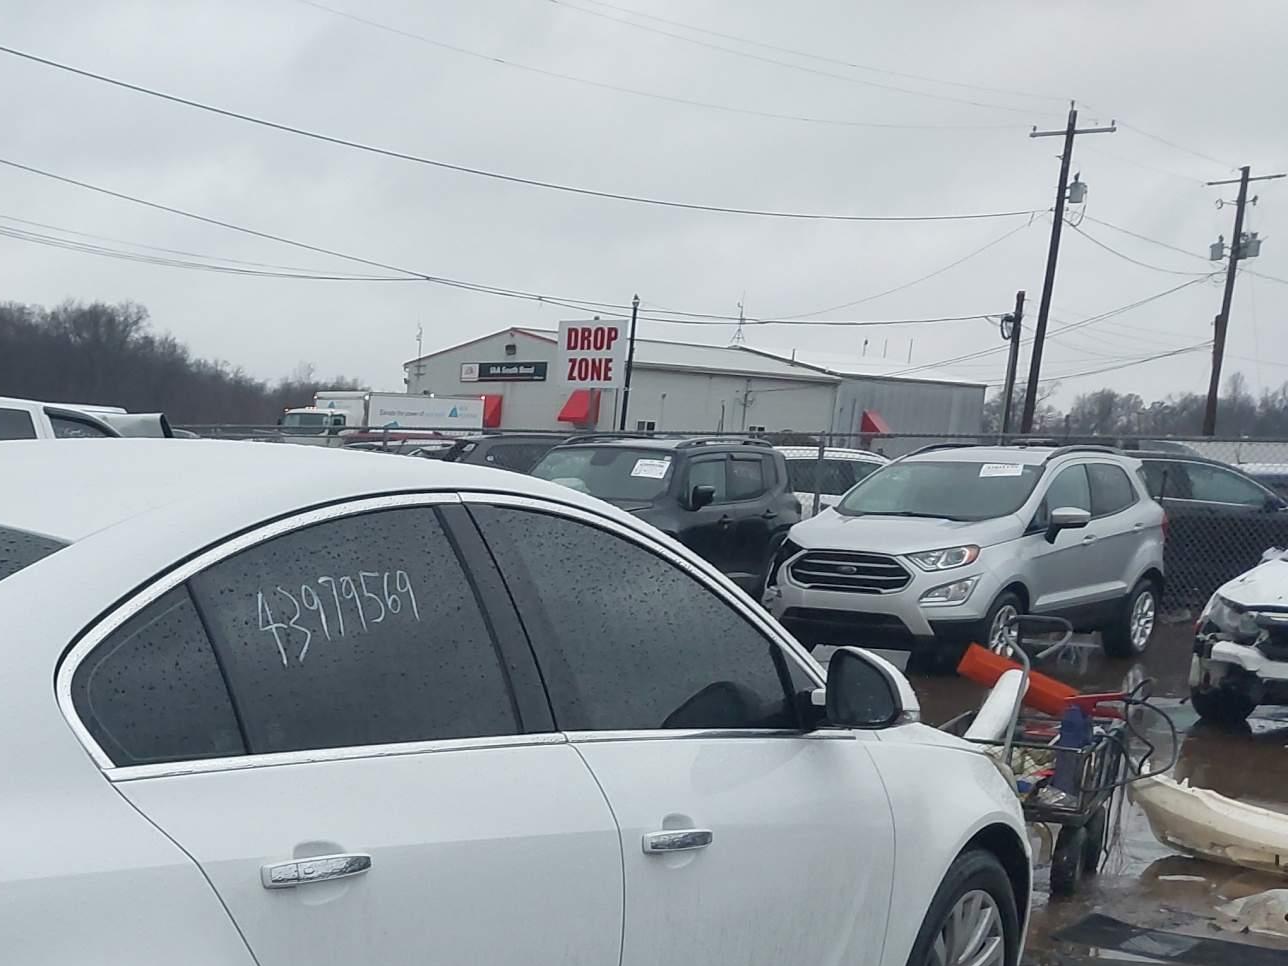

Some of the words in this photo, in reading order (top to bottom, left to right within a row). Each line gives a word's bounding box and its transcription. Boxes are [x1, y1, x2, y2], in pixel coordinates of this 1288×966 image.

[567, 327, 618, 351] DROP
[568, 358, 613, 381] ZONE
[257, 570, 420, 668] 43979569
